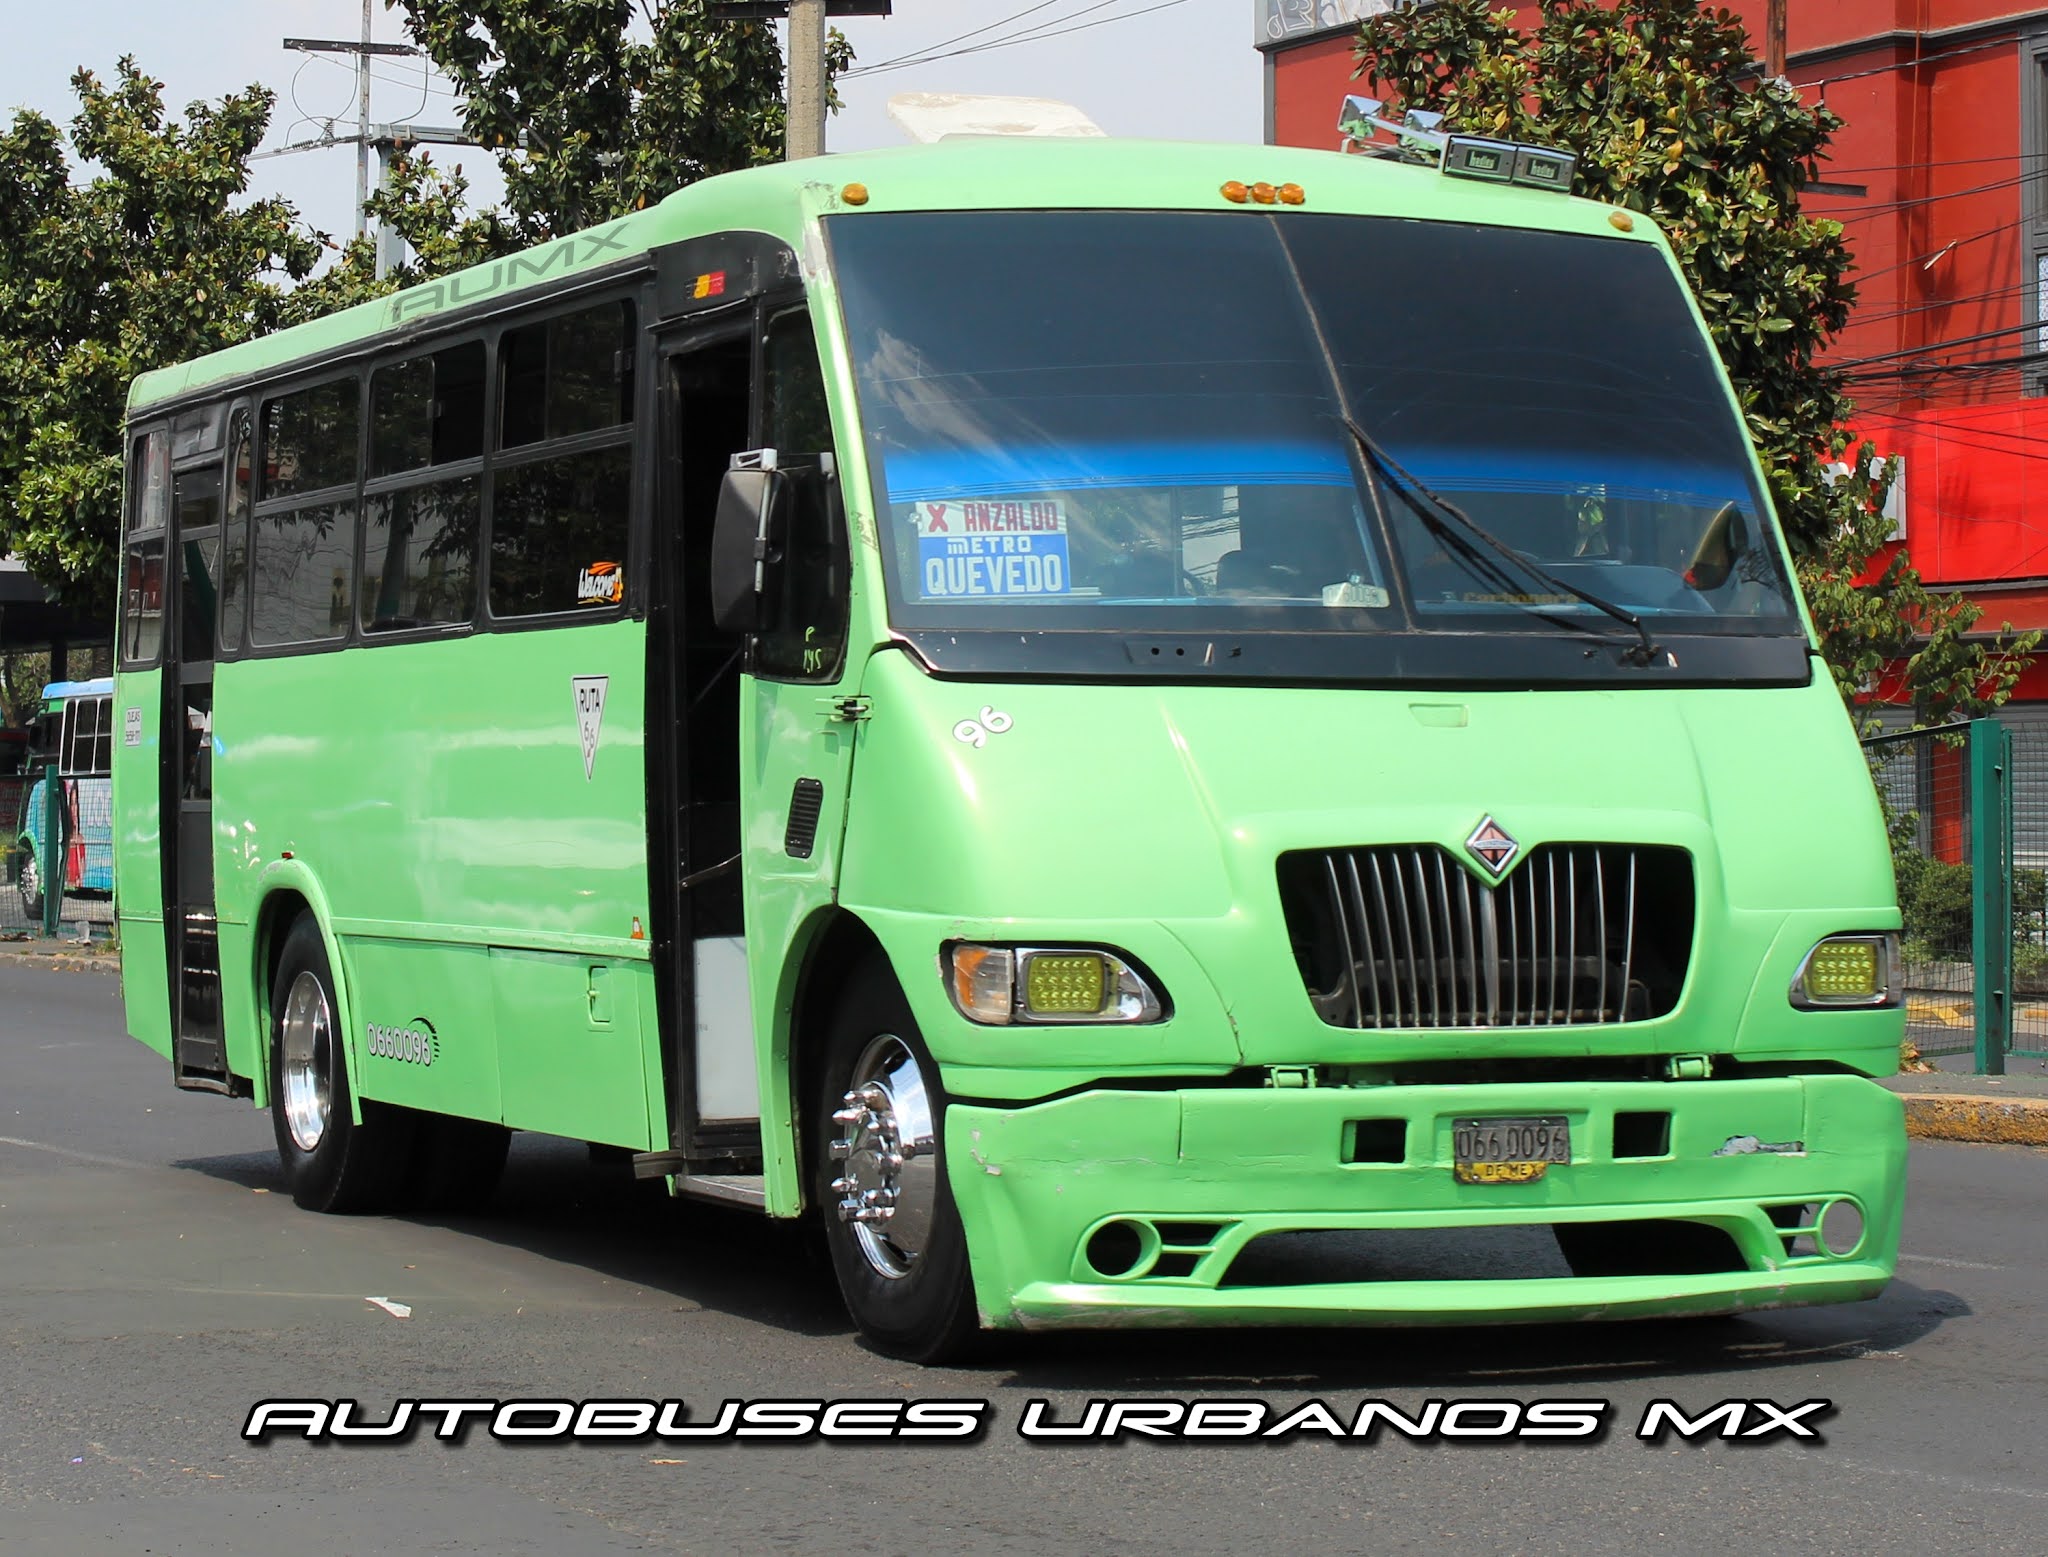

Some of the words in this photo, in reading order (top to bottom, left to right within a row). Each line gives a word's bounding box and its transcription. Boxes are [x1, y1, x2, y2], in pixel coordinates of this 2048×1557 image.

[391, 222, 630, 323] AUMX
[926, 503, 949, 532] X
[963, 502, 1058, 532] ANZALDO
[946, 536, 1032, 555] METRO
[925, 554, 1062, 595] QUEVEDO
[579, 688, 600, 713] RUTA
[952, 704, 1014, 749] 96
[366, 1021, 432, 1067] 0660096
